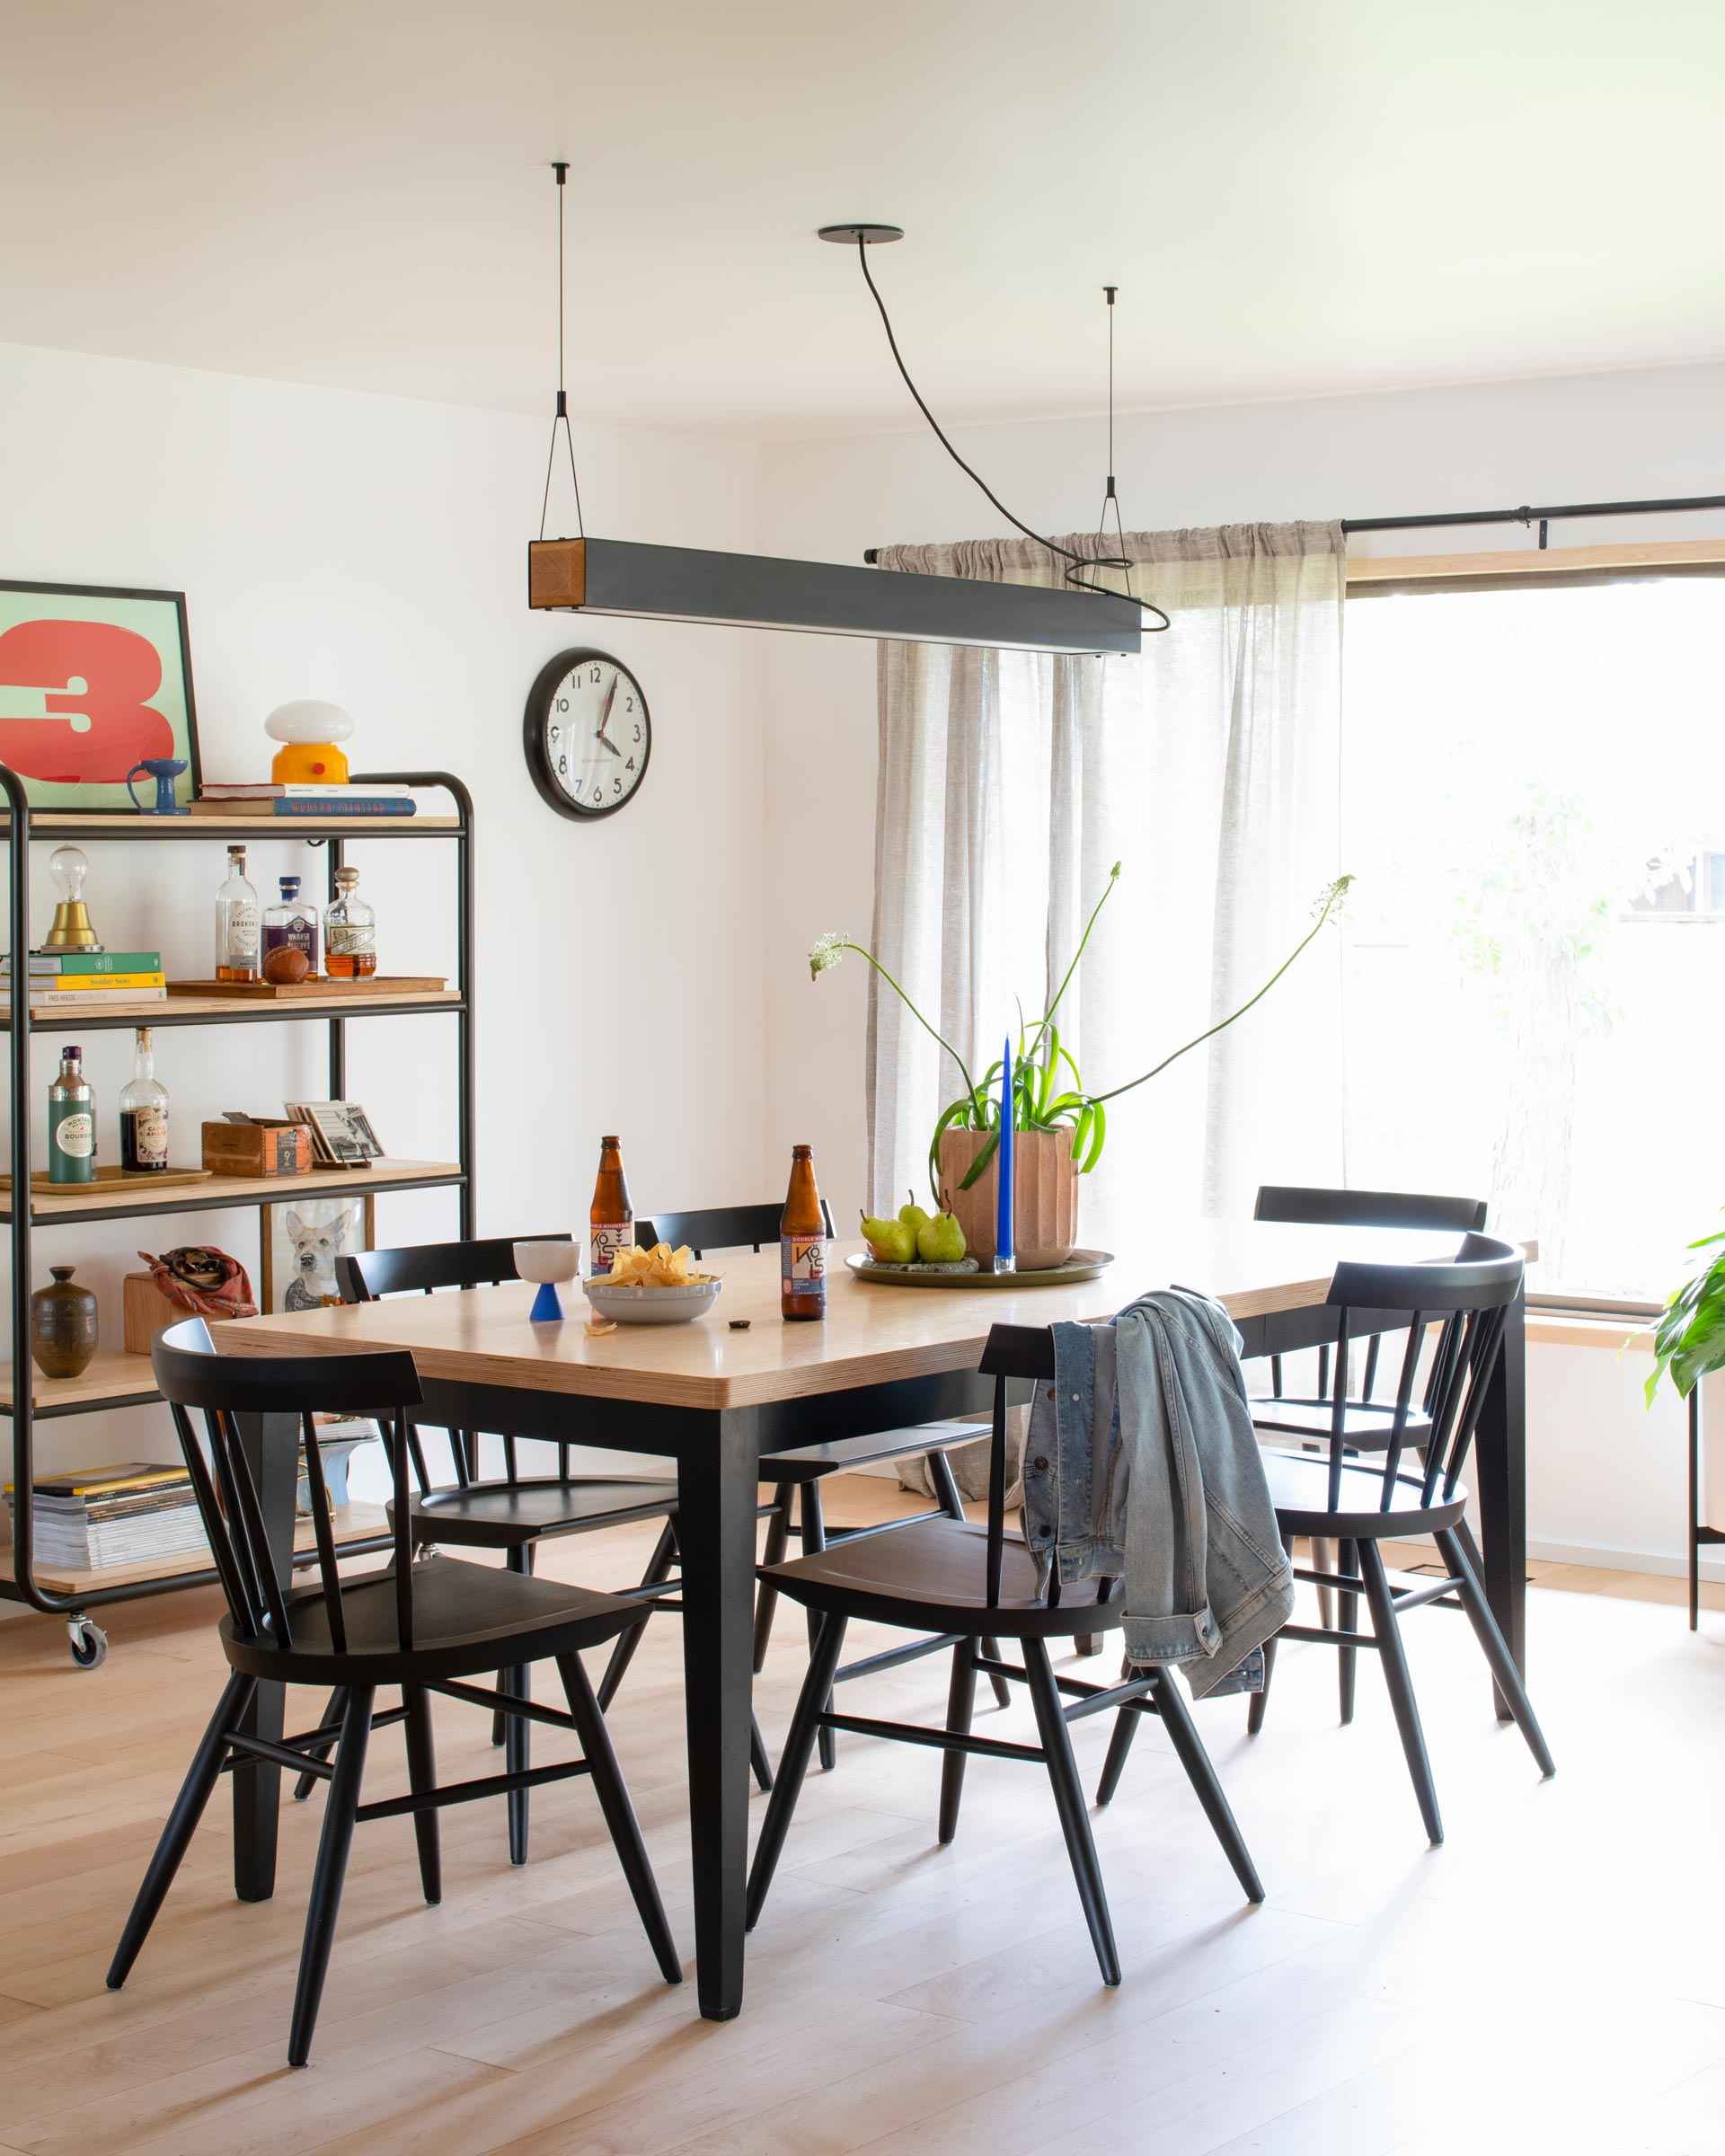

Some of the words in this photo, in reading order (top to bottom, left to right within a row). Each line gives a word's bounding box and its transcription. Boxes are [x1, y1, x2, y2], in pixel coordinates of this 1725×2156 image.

[572, 676, 580, 688] 11
[590, 667, 601, 683] 12
[0, 619, 175, 784] 3
[556, 699, 569, 712] 10
[626, 697, 633, 712] 2
[551, 726, 560, 744] 9
[632, 724, 641, 743] 3
[559, 755, 568, 774] 8
[625, 755, 635, 772] 4
[575, 779, 583, 794] 7
[613, 778, 622, 793] 5
[593, 786, 602, 802] 6
